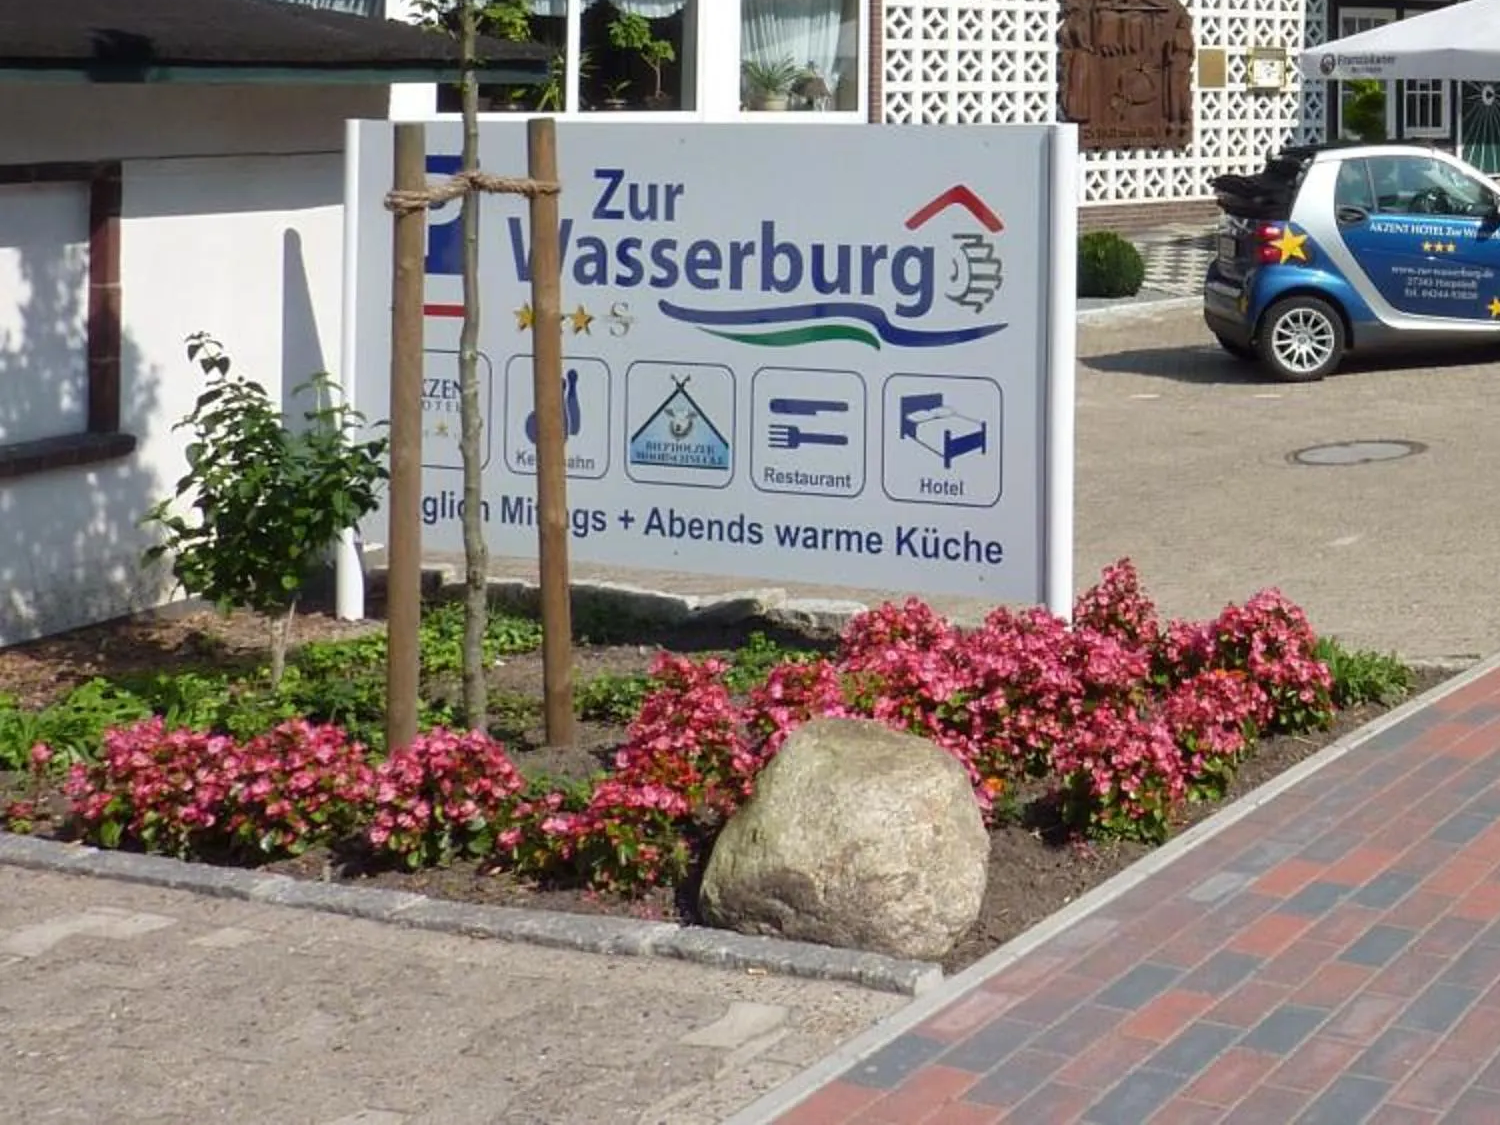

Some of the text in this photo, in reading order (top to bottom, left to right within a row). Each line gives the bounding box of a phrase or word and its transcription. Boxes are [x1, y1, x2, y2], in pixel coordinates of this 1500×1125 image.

[592, 169, 685, 220] Zur
[1411, 224, 1443, 238] HOTEL
[507, 217, 935, 318] Wasserburg
[515, 450, 595, 471] Keahn
[763, 466, 852, 489] Restaurant
[919, 478, 965, 496] Hotel
[501, 495, 607, 538] Migs
[618, 508, 635, 530] +
[644, 505, 765, 546] Abends
[775, 524, 884, 554] warme
[895, 526, 1003, 564] Küche
